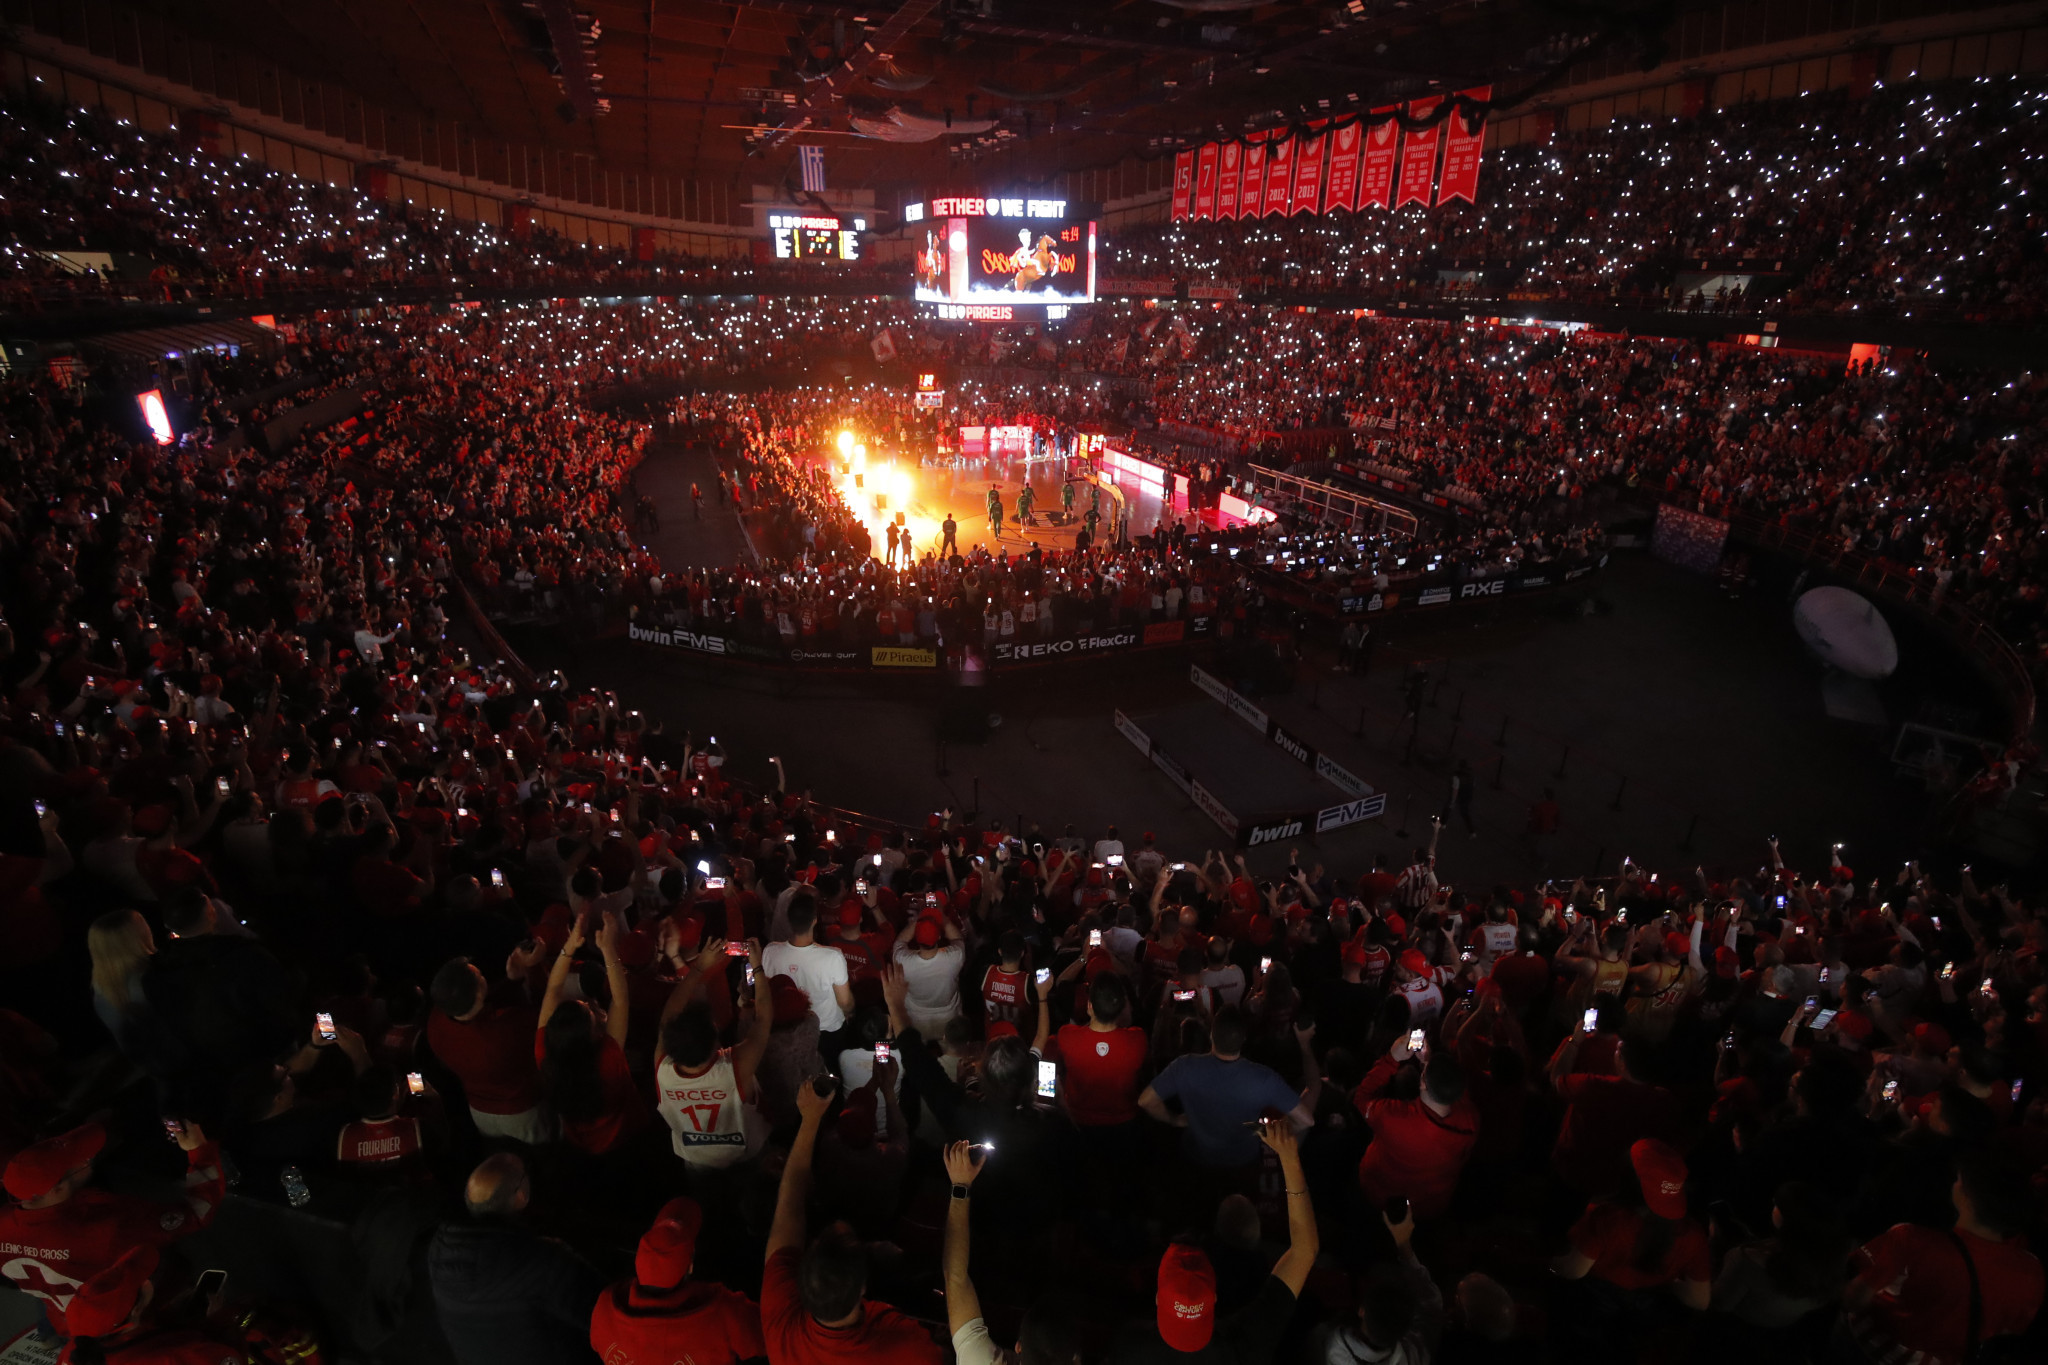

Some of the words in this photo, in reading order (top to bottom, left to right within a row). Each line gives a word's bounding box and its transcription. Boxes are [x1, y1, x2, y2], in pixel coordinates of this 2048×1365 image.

[1176, 166, 1189, 190] 15
[1203, 164, 1211, 188] 7
[1221, 194, 1234, 206] 2013
[1244, 191, 1258, 205] 1997
[1269, 188, 1285, 202] 2012
[1298, 184, 1315, 199] 2013
[1001, 198, 1024, 217] WE
[1027, 199, 1066, 218] FIGHT
[801, 217, 839, 229] PIRAEUS
[1460, 580, 1505, 598] AXE
[629, 622, 671, 646] bwin
[673, 629, 725, 653] FMS
[1032, 639, 1074, 656] EKO
[1088, 633, 1136, 649] FlexCar
[890, 651, 934, 663] Piraeus
[1238, 699, 1260, 721] MARINE
[1274, 727, 1308, 763] bwin
[1332, 765, 1362, 791] MARINE
[1201, 794, 1238, 837] FlexCar
[1319, 795, 1385, 829] FMS
[1248, 818, 1303, 847] bwin
[990, 991, 1015, 1002] FMS
[991, 980, 1016, 995] FOURNIER
[665, 1089, 727, 1101] ERCEG
[680, 1103, 721, 1133] 17
[357, 1136, 401, 1158] FOURNIER
[686, 1134, 742, 1142] VOLVO
[23, 1246, 39, 1257] RED
[40, 1248, 70, 1260] CROSS
